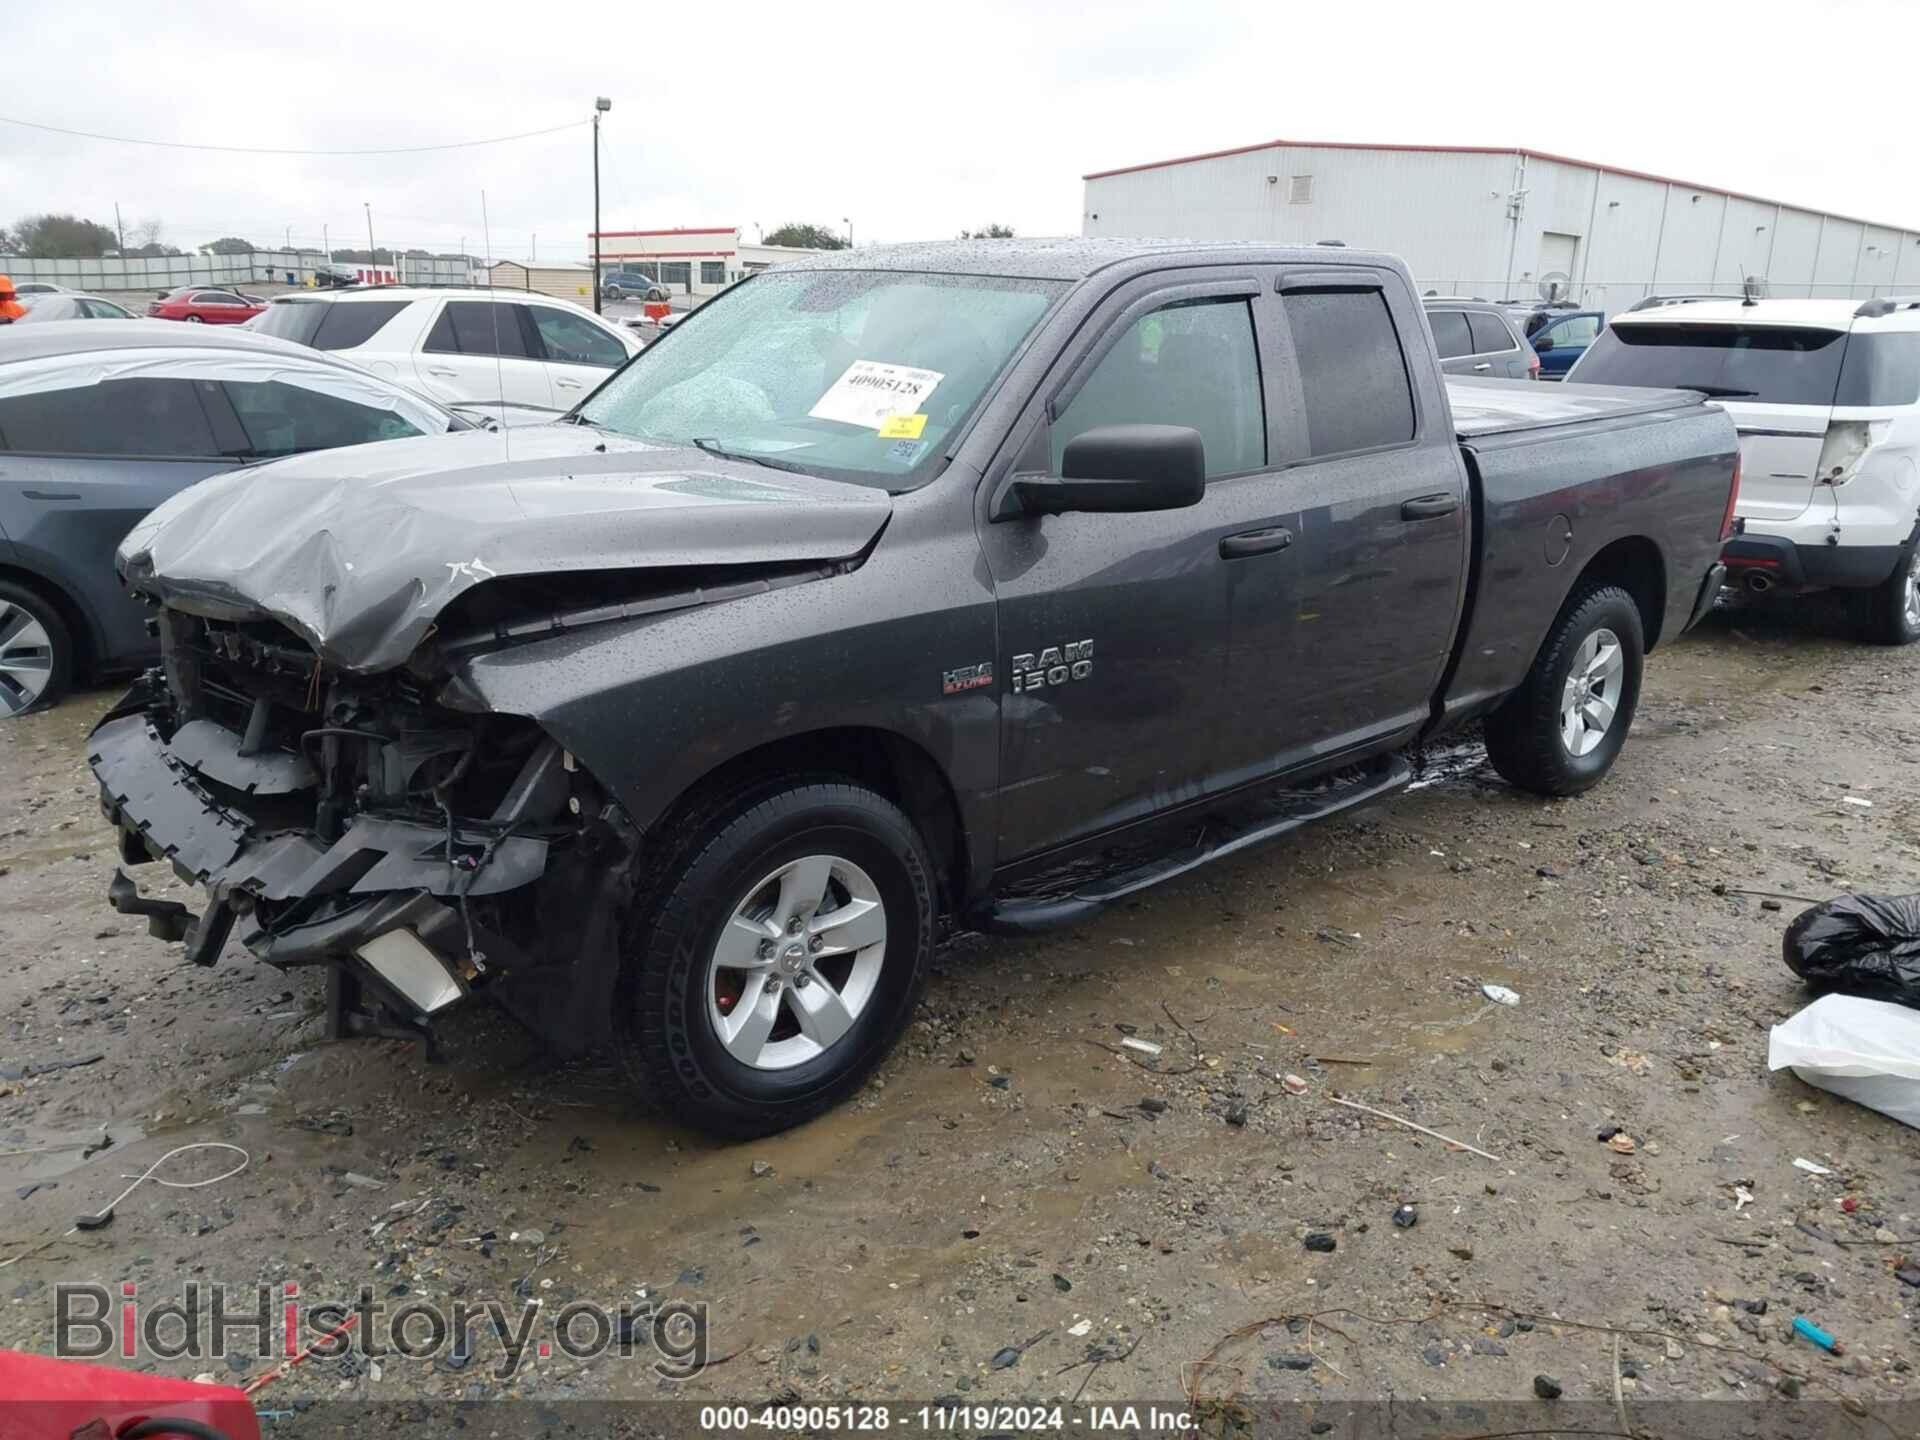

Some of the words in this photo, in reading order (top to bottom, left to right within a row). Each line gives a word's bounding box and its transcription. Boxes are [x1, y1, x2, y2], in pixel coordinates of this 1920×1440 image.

[848, 374, 923, 395] 40905128
[1012, 639, 1094, 674] RAM
[1012, 660, 1093, 693] 1500
